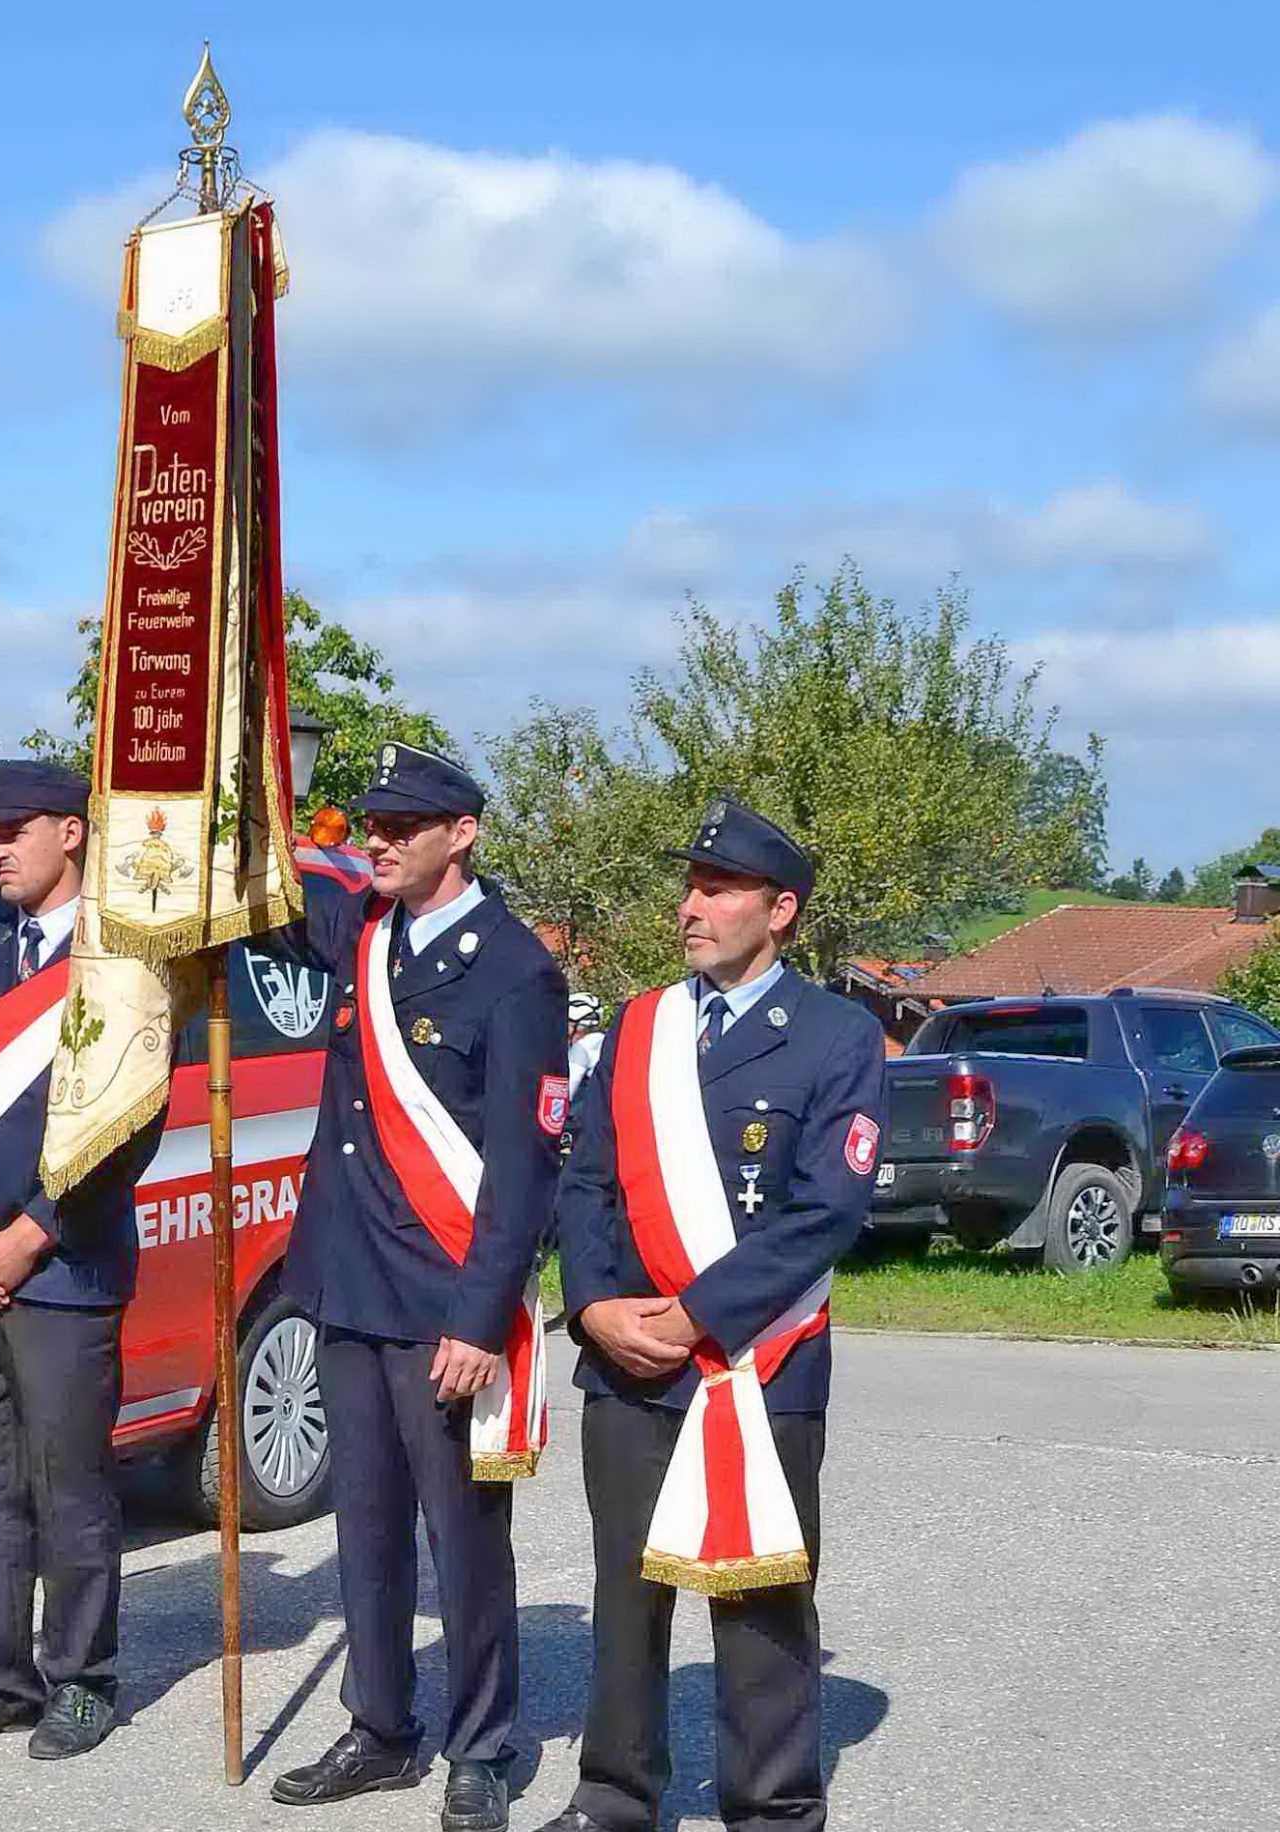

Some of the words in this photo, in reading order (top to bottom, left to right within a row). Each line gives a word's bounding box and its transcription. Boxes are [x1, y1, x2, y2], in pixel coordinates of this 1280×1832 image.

[160, 404, 191, 426] Vom
[141, 494, 205, 525] verein
[127, 611, 195, 631] Feuerwehr
[128, 646, 191, 676] Törwang
[135, 689, 148, 700] zu
[151, 682, 186, 699] Eurem
[132, 705, 154, 730] 100
[128, 737, 187, 763] Jubiläum
